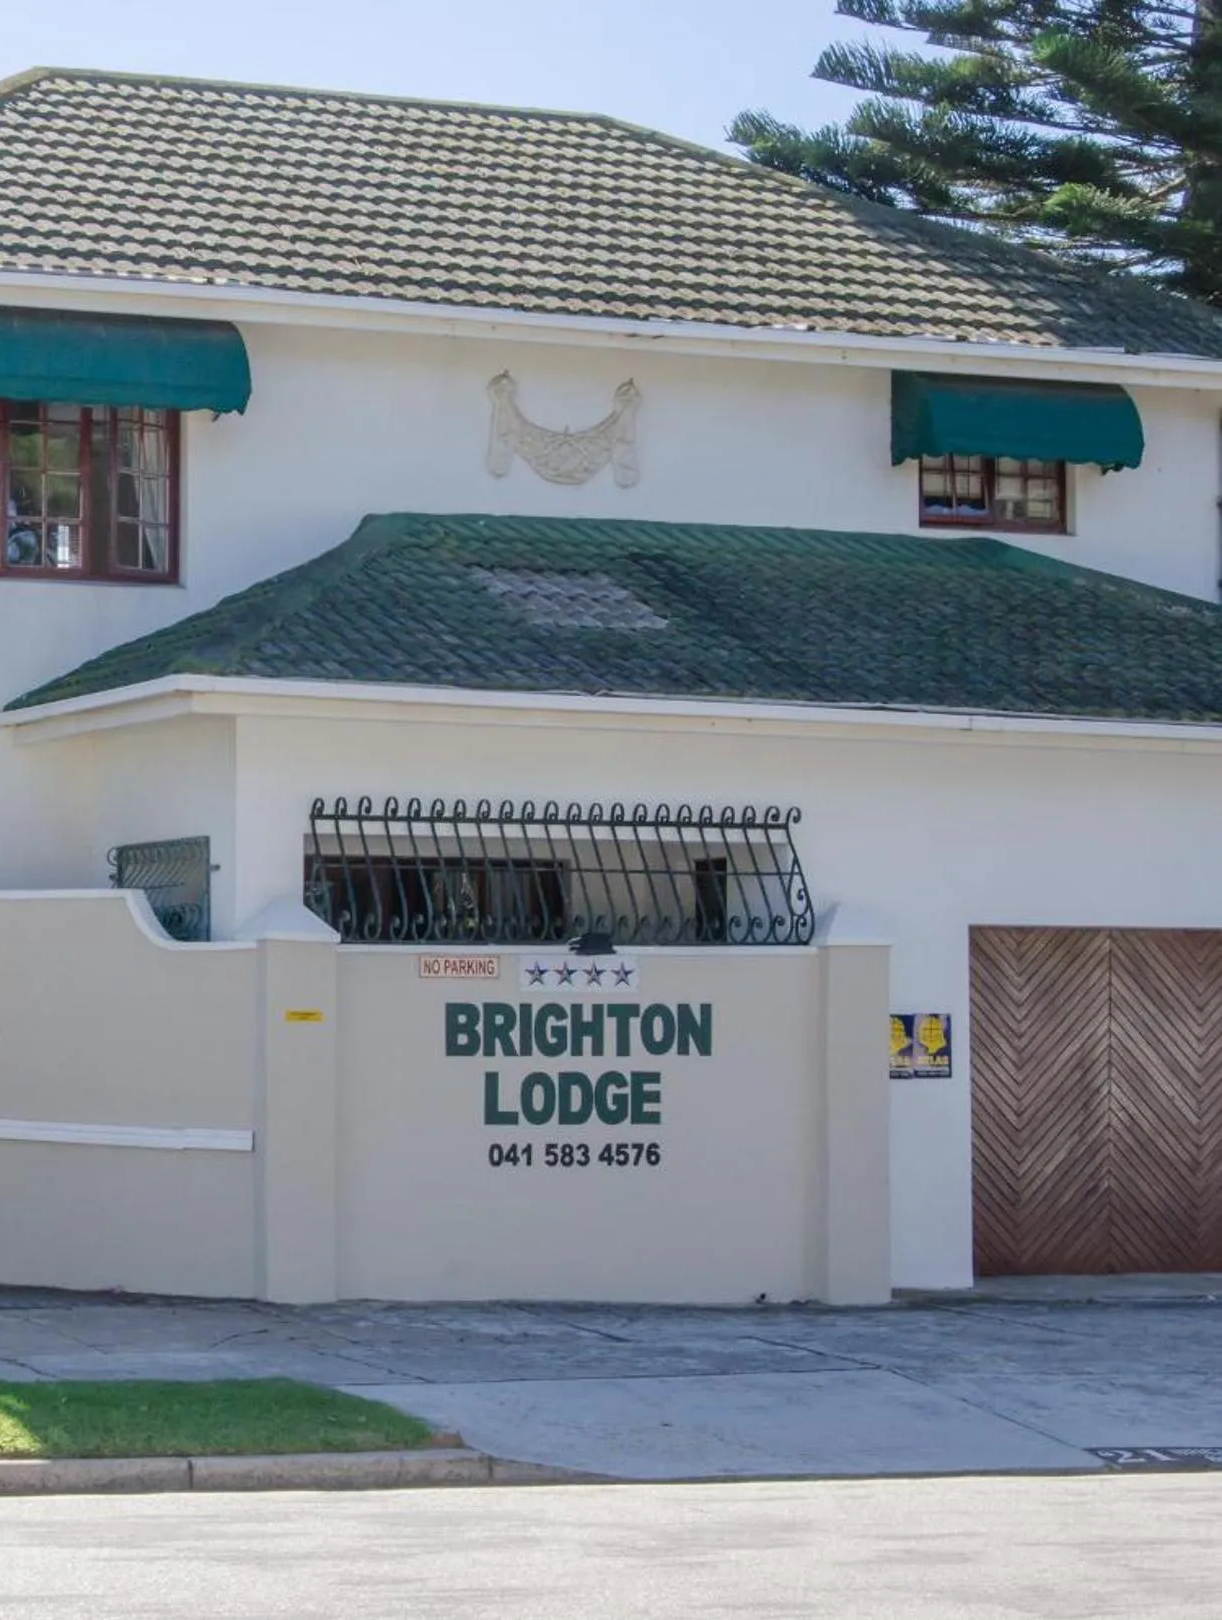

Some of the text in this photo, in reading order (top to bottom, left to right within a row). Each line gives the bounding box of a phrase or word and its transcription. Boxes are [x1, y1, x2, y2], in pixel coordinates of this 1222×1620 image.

[423, 959, 495, 976] NO PARKING
[445, 1002, 712, 1057] BRIGHTON
[484, 1070, 661, 1125] LODGE
[488, 1142, 661, 1166] 041 583 4576
